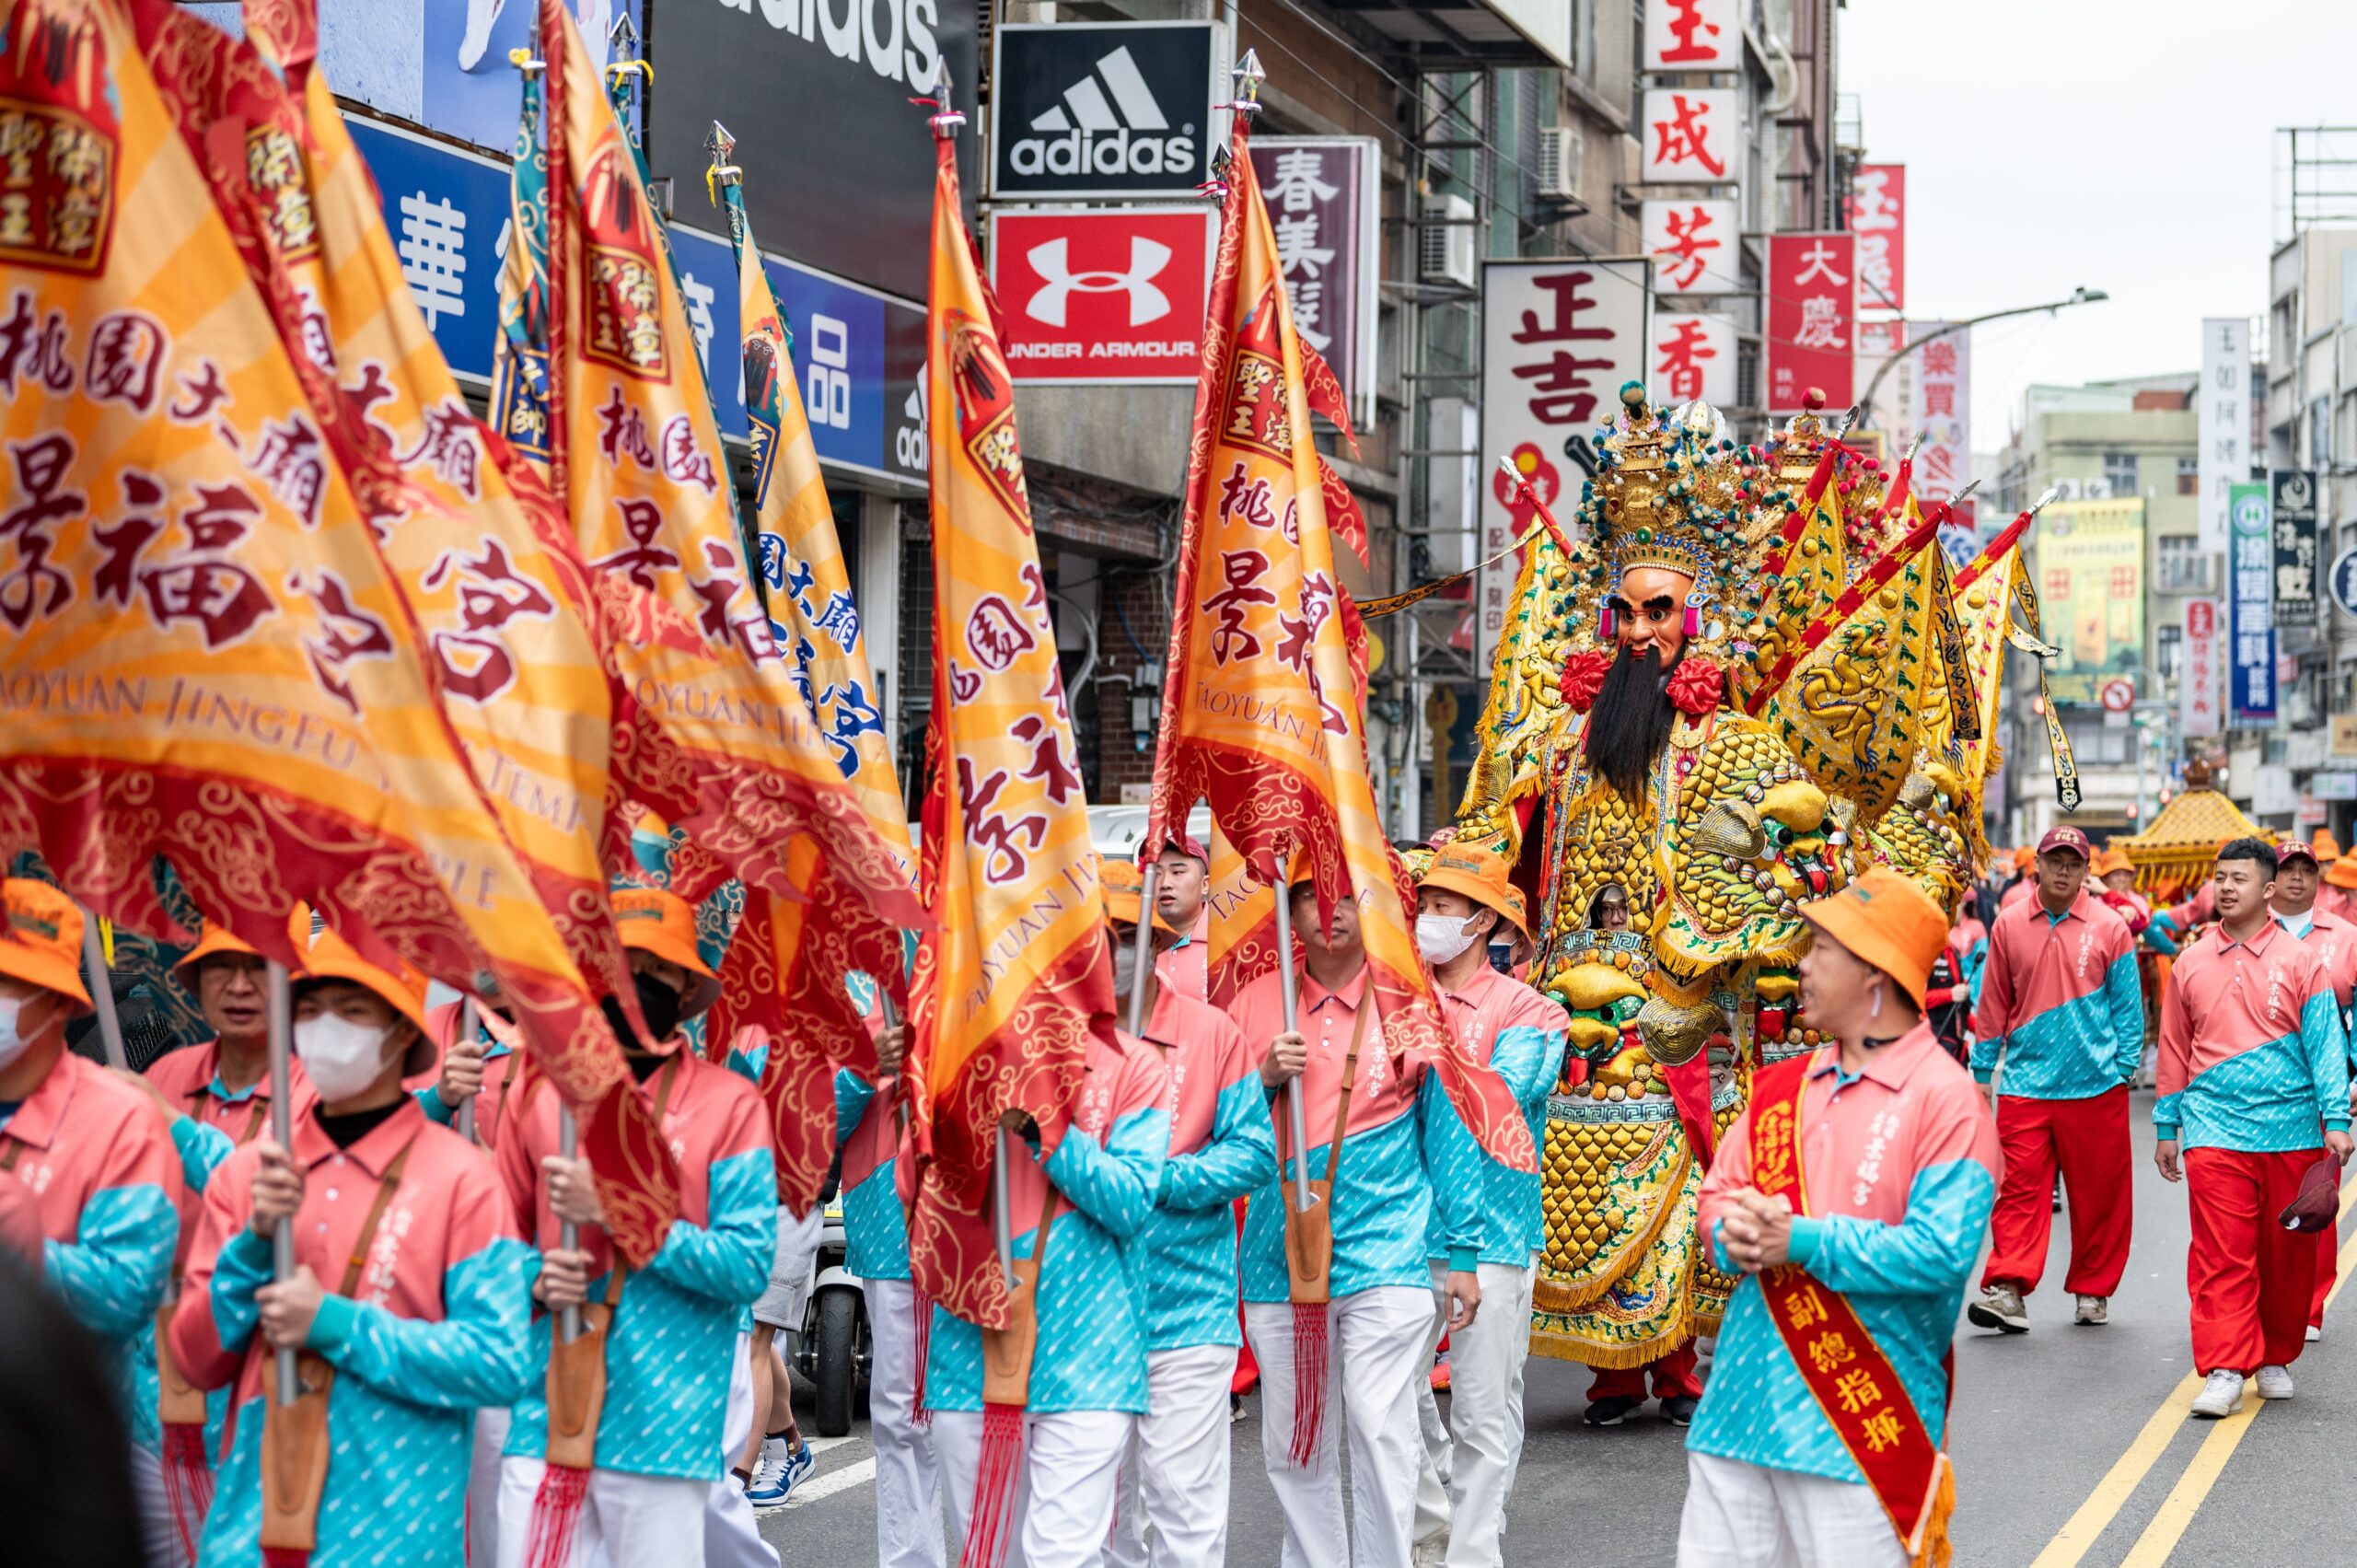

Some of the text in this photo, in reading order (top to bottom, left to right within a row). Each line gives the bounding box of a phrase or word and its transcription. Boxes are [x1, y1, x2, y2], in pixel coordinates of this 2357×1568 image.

[1011, 127, 1195, 176] adidas
[1795, 239, 1848, 348] 大慶
[1089, 341, 1196, 357] ARMOUR
[1511, 272, 1617, 425] 正吉
[1228, 357, 1273, 436] 聖王
[164, 677, 357, 772] JINGFU
